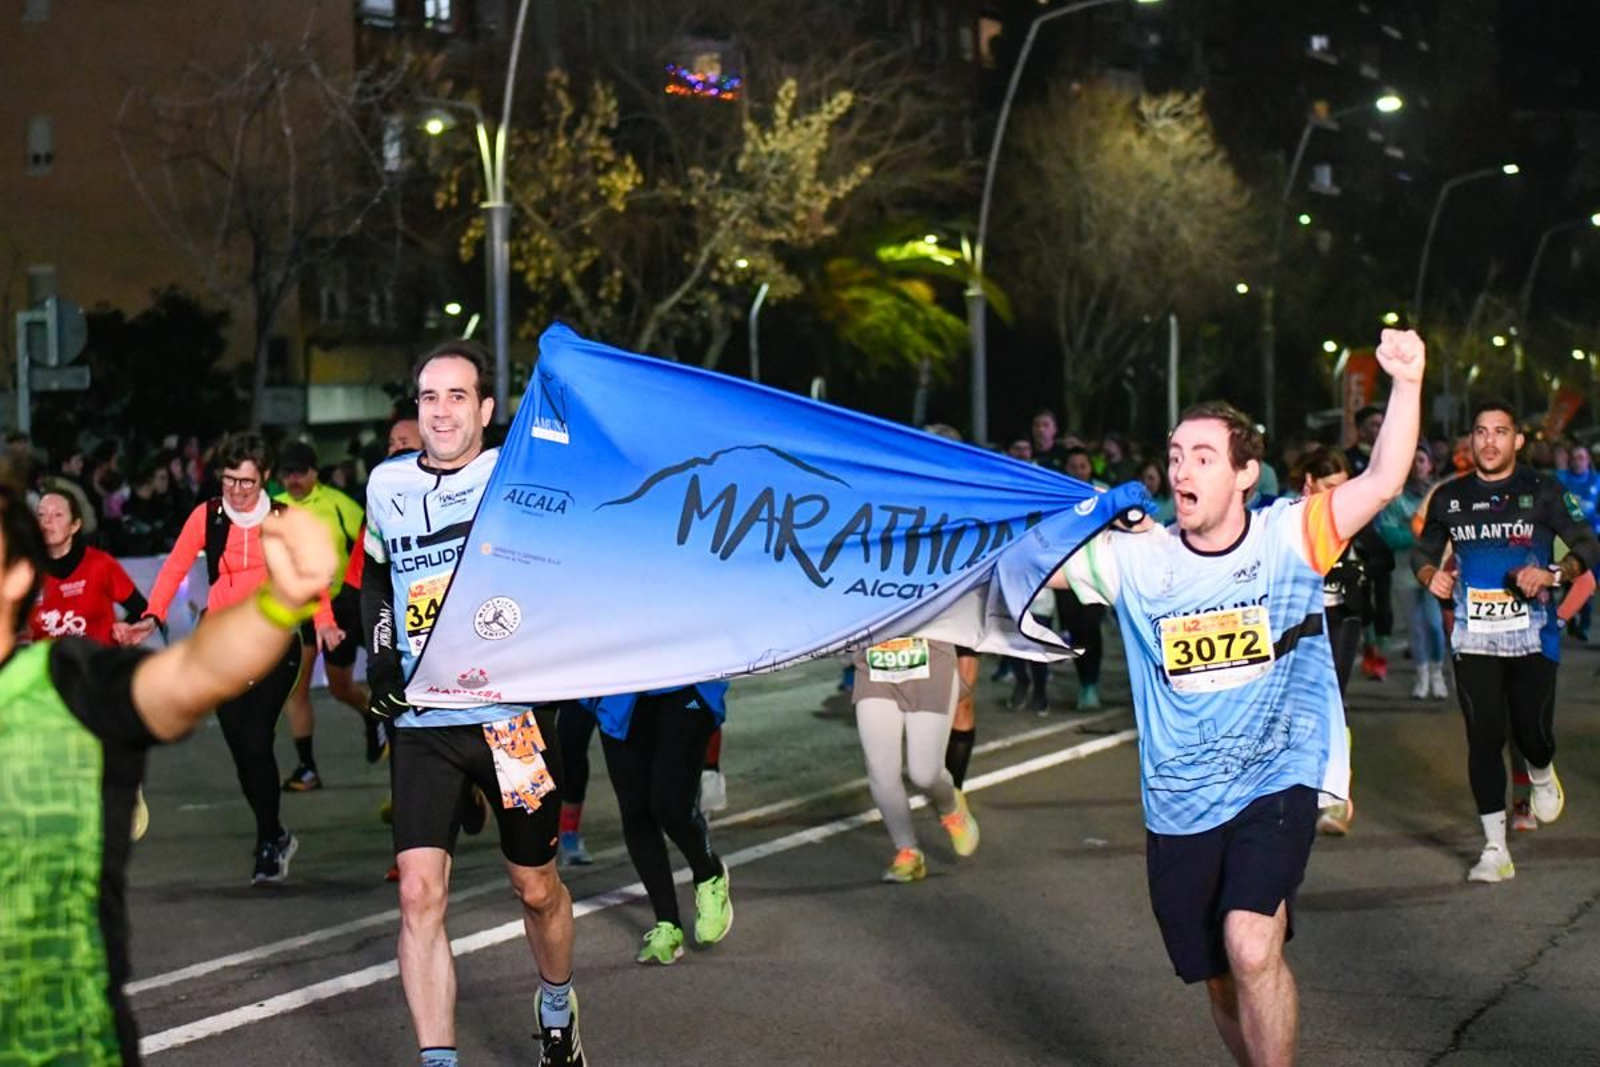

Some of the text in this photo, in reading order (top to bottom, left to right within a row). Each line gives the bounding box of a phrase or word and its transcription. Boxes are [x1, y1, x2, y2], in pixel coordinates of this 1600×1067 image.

[1450, 524, 1477, 541] SAN
[1480, 519, 1534, 541] ANTÓN
[1472, 600, 1522, 617] 7270
[1172, 630, 1262, 666] 3072
[872, 650, 923, 669] 2907
